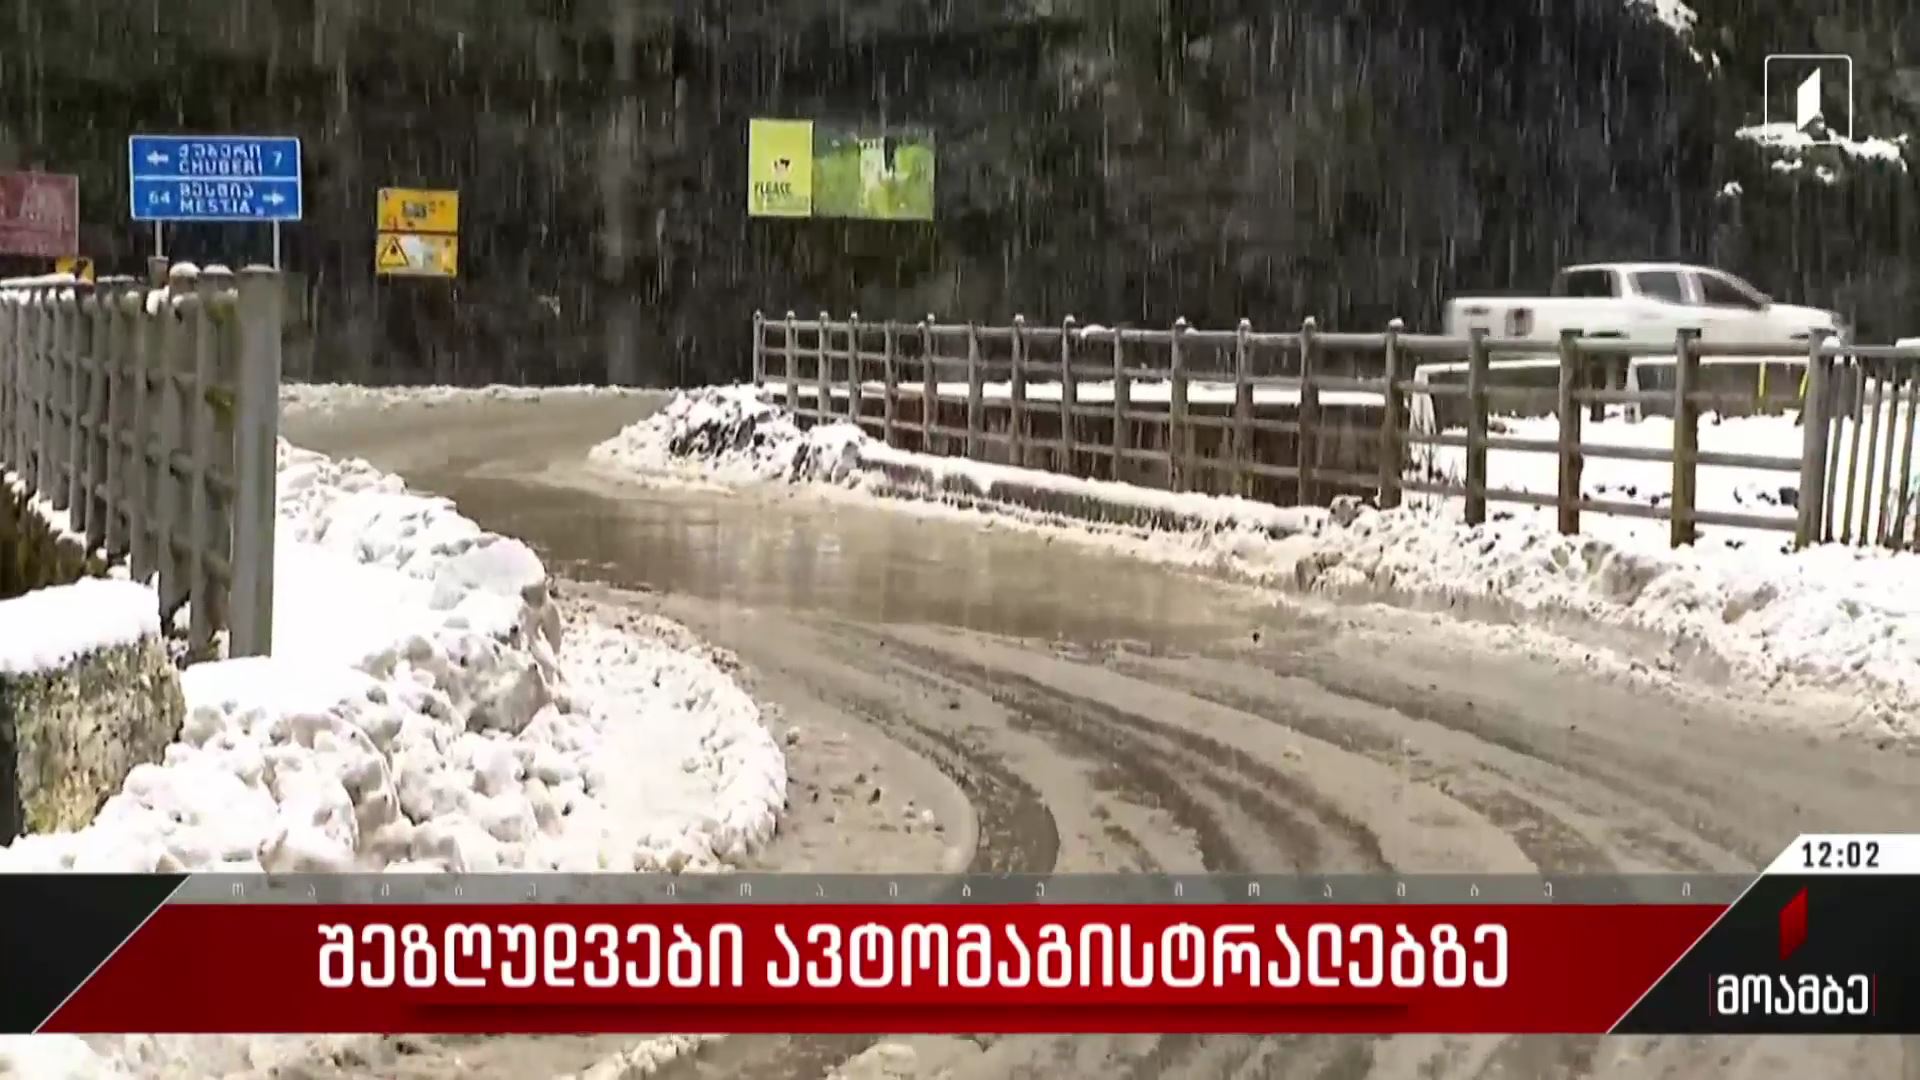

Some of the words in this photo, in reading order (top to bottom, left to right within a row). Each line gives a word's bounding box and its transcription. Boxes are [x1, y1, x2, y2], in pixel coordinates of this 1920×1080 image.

[179, 158, 263, 175] CHUBERI
[273, 151, 283, 167] 7
[180, 199, 250, 214] MESTIA
